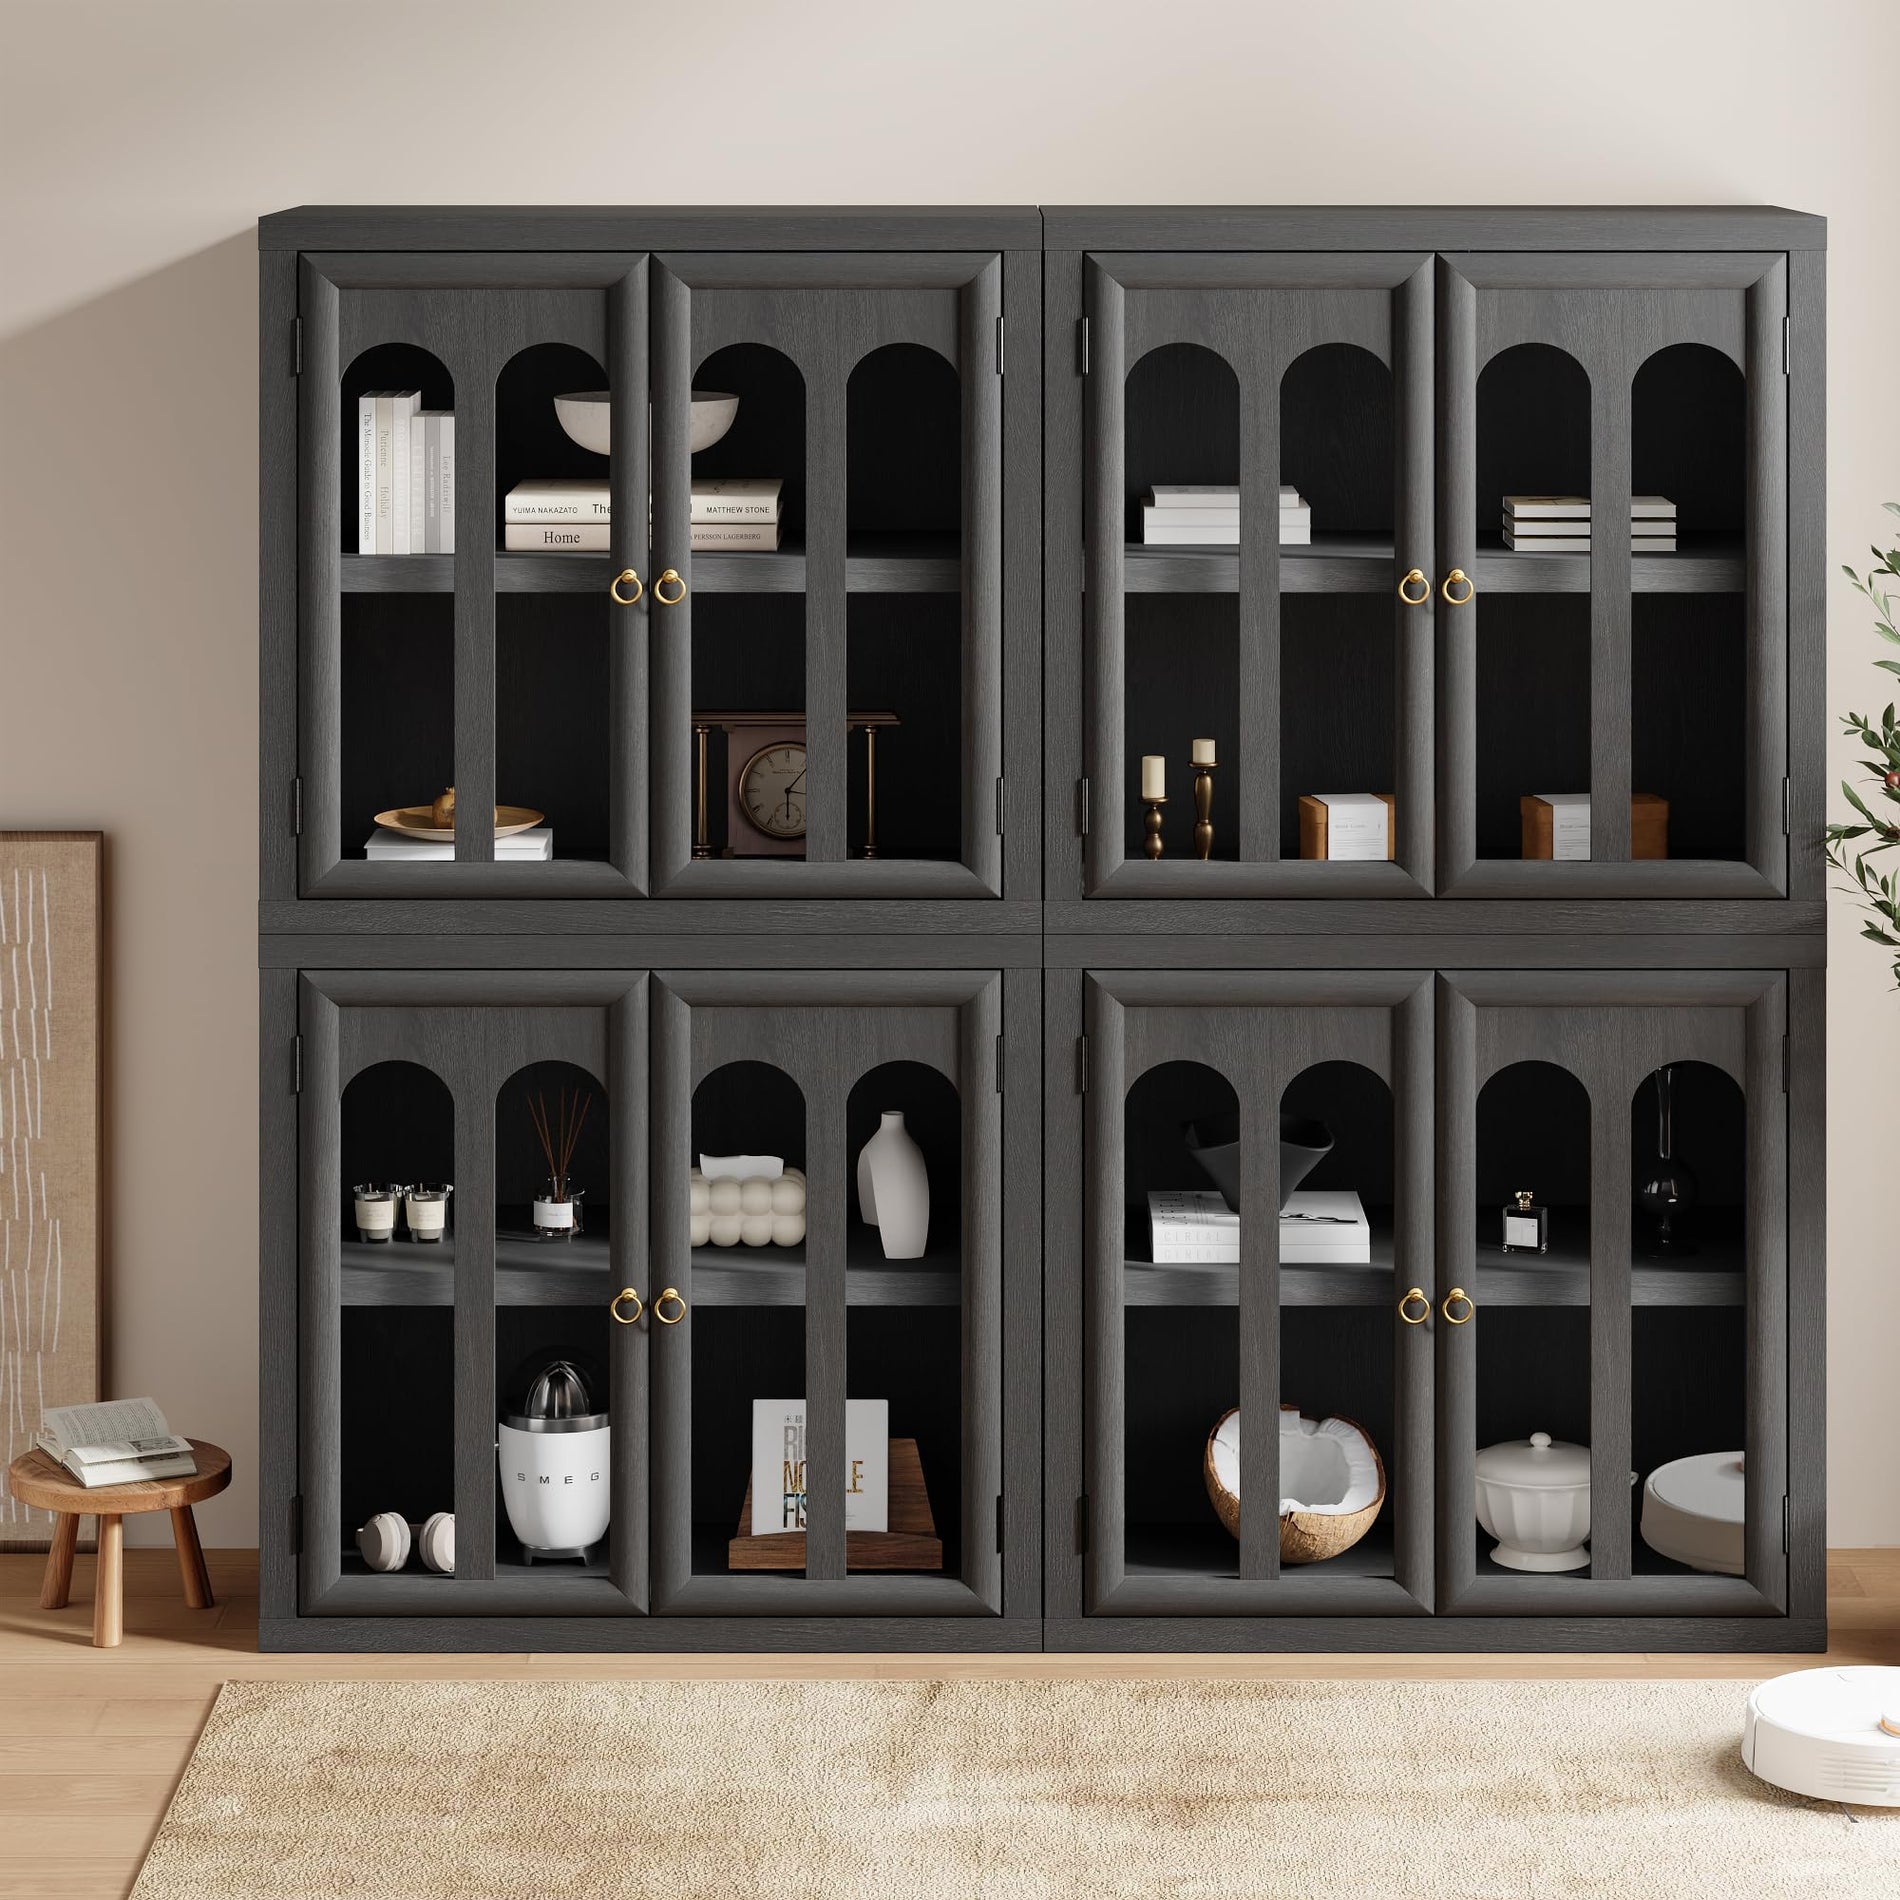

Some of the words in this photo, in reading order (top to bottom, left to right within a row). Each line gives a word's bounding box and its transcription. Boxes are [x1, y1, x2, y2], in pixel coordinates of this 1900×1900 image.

[363, 413, 372, 426] The
[363, 458, 372, 481] Guide
[442, 456, 451, 470] Lee
[363, 490, 372, 510] Good
[379, 486, 390, 519] Holiday
[512, 506, 537, 514] YUIMA
[538, 506, 579, 514] NAKAZATO
[706, 506, 743, 514] MATTHEW
[744, 506, 770, 514] STONE
[543, 531, 581, 544] Home
[693, 533, 722, 541] PERSSON
[723, 533, 761, 541] LAGERBERG
[517, 1471, 600, 1485] SMEG
